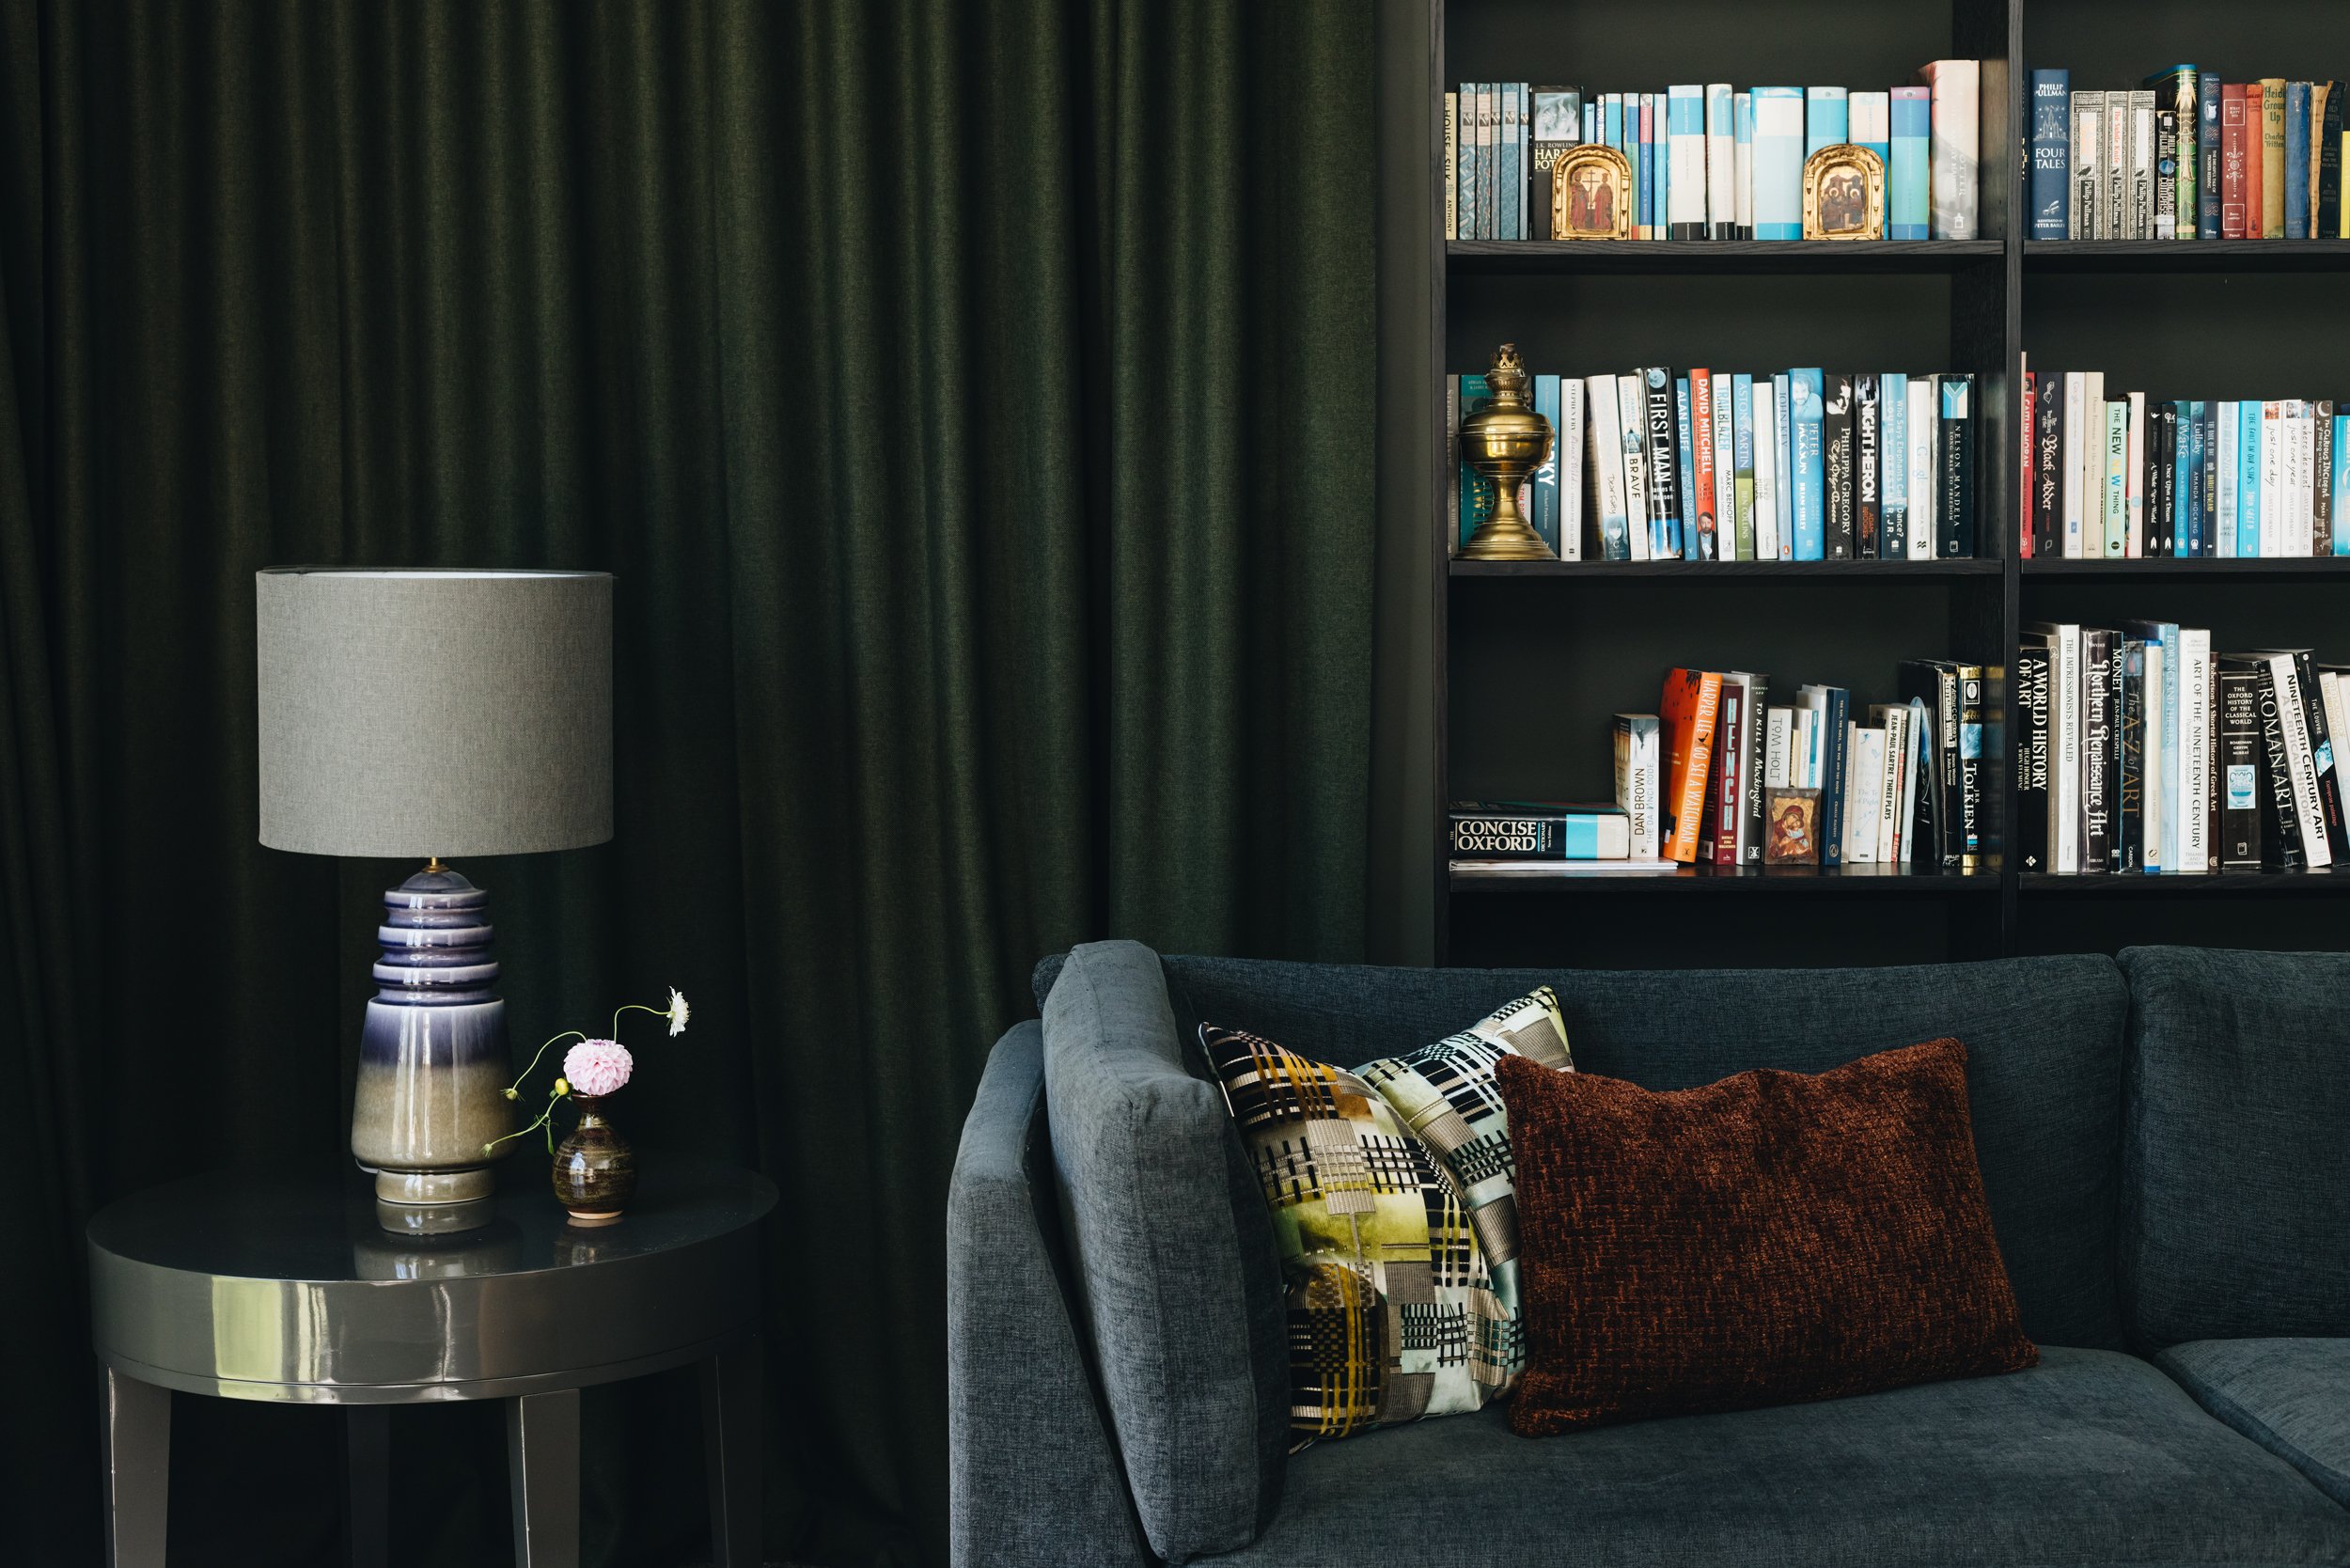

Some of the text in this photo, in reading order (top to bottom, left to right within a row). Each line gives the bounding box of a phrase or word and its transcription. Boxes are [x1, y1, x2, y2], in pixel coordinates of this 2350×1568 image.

[1597, 95, 1605, 105] SO
[2034, 89, 2068, 98] PULLMAN
[2038, 83, 2064, 91] PHILIP
[2264, 86, 2286, 99] Heidi
[2270, 110, 2281, 125] Up
[1534, 149, 1569, 160] HAR
[2033, 159, 2066, 170] TALES
[2035, 148, 2066, 159] FOUR
[2083, 180, 2092, 200] Philip
[2112, 180, 2122, 199] Philip
[2138, 181, 2147, 227] Philip Pullman
[2159, 177, 2168, 216] COMPASS
[1677, 390, 1689, 452] ALAN DUFF
[1716, 385, 1731, 451] TRAILBLAZER
[1739, 382, 1749, 469] ASTON MARTIN
[1895, 400, 1904, 417] Who
[1650, 393, 1671, 483] FIRST MAN
[1698, 378, 1712, 476] DAVID MITCHELL
[1810, 422, 1819, 457] PETER
[1895, 419, 1904, 440] Says
[2111, 427, 2122, 456] NEW
[2191, 422, 2203, 455] Lullaby
[2266, 425, 2278, 447] just
[2287, 425, 2298, 446] just
[1796, 422, 1809, 476] JACKSON
[1861, 400, 1875, 502] NIGHT HERON
[1894, 441, 1904, 487] Elephants
[2302, 425, 2312, 490] where she went
[1841, 427, 1852, 536] PHILIPPA GREGORY
[1949, 475, 1955, 485] TO
[1952, 425, 1962, 527] NELSON MANDELA
[2042, 434, 2058, 510] Black Adder
[2111, 458, 2122, 488] NEW
[2264, 468, 2278, 487] day
[2286, 465, 2297, 488] year
[1740, 490, 1749, 541] BEN COLLINS
[1798, 508, 1807, 531] SIBLEY
[1895, 508, 1904, 538] Dance?
[2019, 658, 2032, 709] OF ART
[2112, 648, 2122, 693] MONET
[2193, 658, 2202, 681] ART
[2209, 662, 2217, 700] Robertson
[1697, 680, 1719, 734] HARPER LEE
[2065, 638, 2074, 762] THE IMPRESSIONISTS REVEALED
[2193, 683, 2202, 698] OF
[1756, 702, 1763, 715] TO
[2031, 658, 2046, 791] A WORLD HISTORY
[2193, 700, 2202, 723] THE
[1693, 746, 1709, 760] GO
[1769, 717, 1783, 782] TOM HOLT
[2081, 659, 2110, 838] Northern Renaissance Art
[2123, 691, 2140, 818] The A-Z of ART
[2192, 727, 2202, 796] NINETEENTH
[2208, 738, 2217, 766] History
[2259, 686, 2285, 771] ROMAN
[2272, 775, 2294, 813] ART
[2280, 695, 2312, 826] A CRITICAL HISTORY
[2286, 674, 2325, 842] NINETEENTH CENTURY ART
[1691, 762, 1707, 778] SET
[1884, 713, 1899, 821] JEAN-PAUL SARTRE THREE PLAYS
[2209, 767, 2217, 776] of
[1634, 768, 1645, 836] DAN BROWN
[1748, 758, 1763, 820] Mockingbird
[1963, 762, 1978, 830] TOLKIEN
[2209, 776, 2217, 798] Greek
[1457, 821, 1538, 836] CONCISE
[1647, 814, 1654, 827] DA
[1681, 792, 1703, 844] WATCHMAN
[2191, 799, 2201, 850] CENTURY
[1457, 836, 1538, 852] OXFORD
